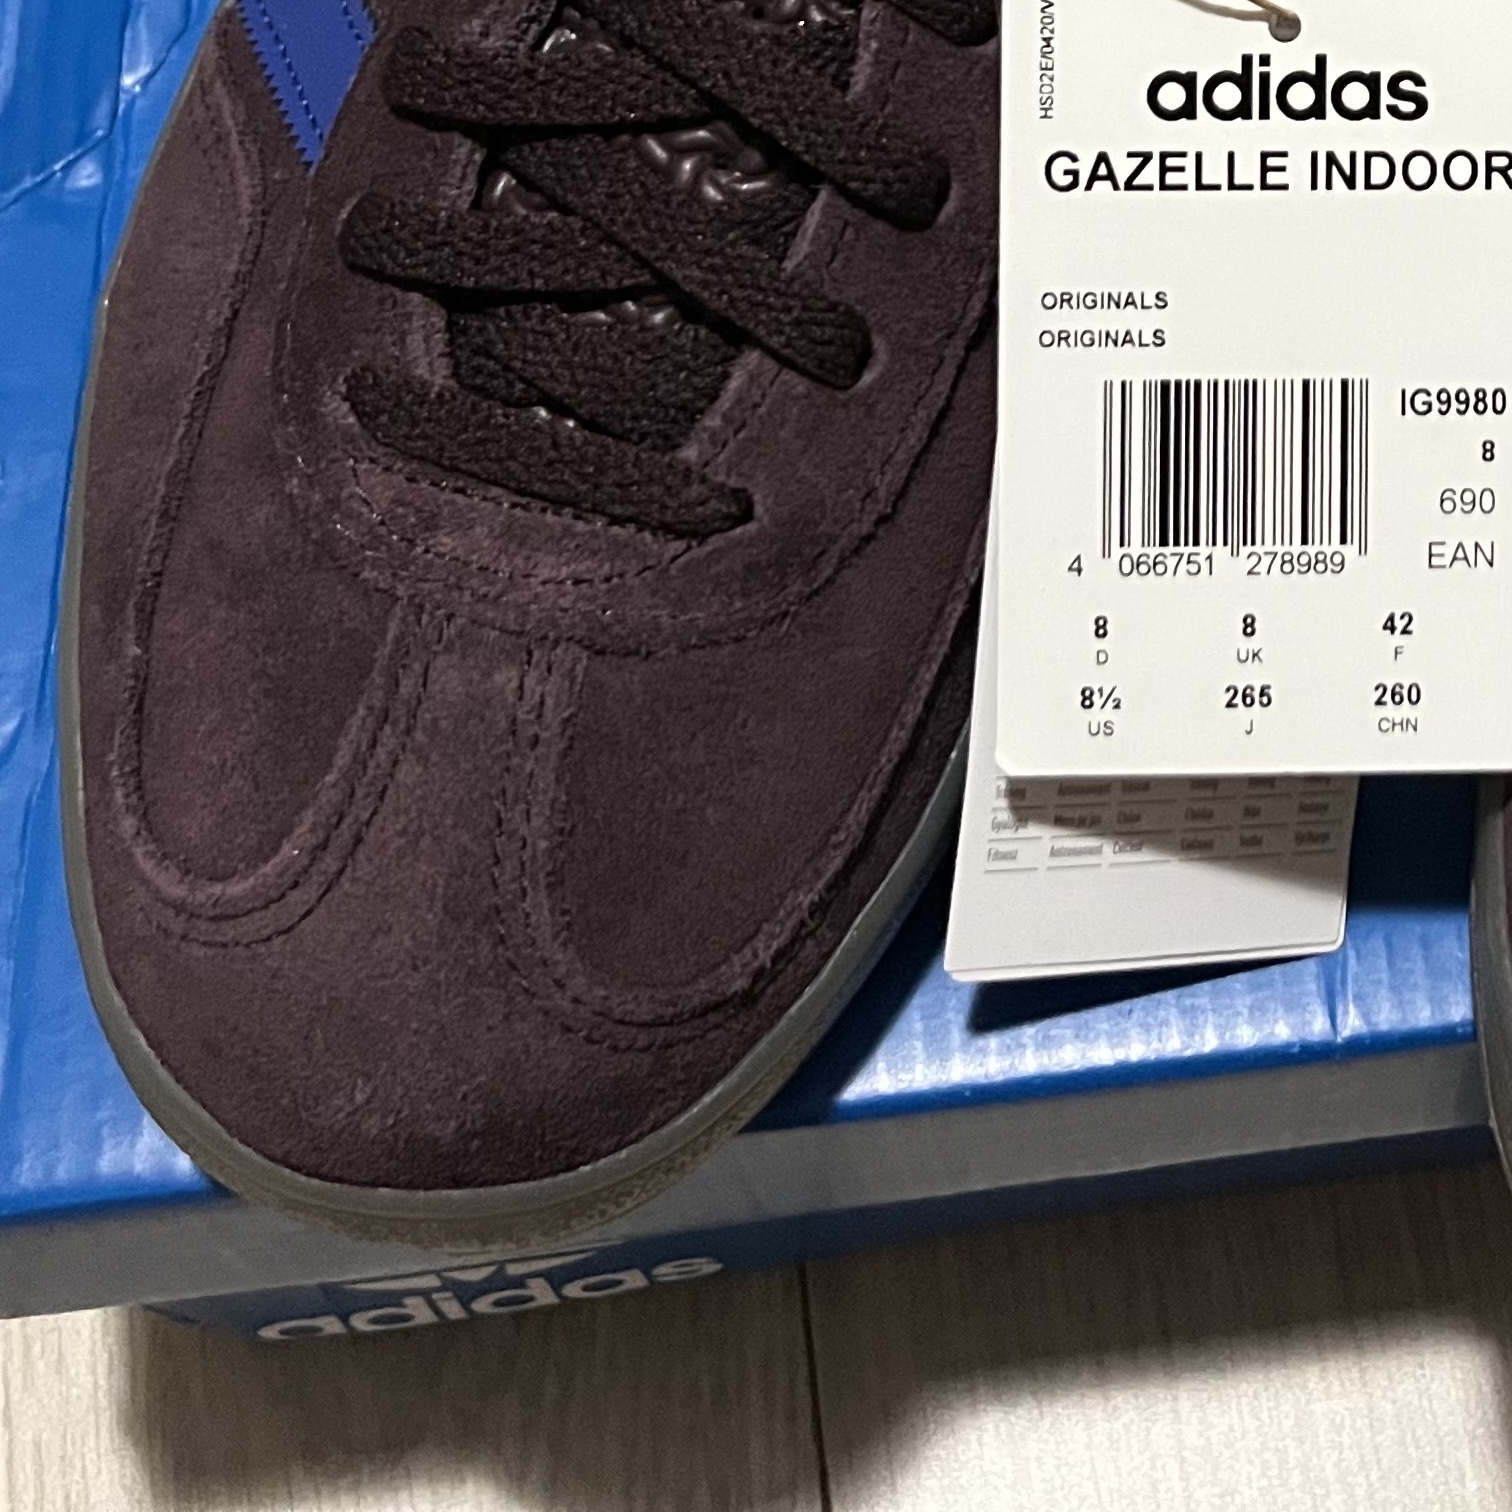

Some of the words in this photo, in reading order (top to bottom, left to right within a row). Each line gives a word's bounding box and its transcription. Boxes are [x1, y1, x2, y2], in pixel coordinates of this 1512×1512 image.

[1146, 52, 1429, 122] adidas
[1044, 149, 1290, 193] GAZELLE
[1040, 290, 1169, 311] ORIGINALS
[1038, 328, 1166, 348] ORIGINALS
[1400, 387, 1508, 416] IG9980
[1481, 439, 1496, 463] 8
[1439, 487, 1496, 515] 690
[1067, 554, 1084, 578] 4
[1118, 551, 1214, 578] 066751
[1246, 550, 1346, 576] 278989
[1427, 540, 1495, 570] EAN
[1093, 615, 1109, 640] 8
[1241, 614, 1257, 638] 8
[1381, 611, 1414, 636] 42
[1096, 649, 1109, 666] D
[1236, 647, 1263, 664] UK
[1394, 645, 1405, 662] F
[1224, 684, 1273, 709] 265
[1373, 682, 1422, 707] 260
[1088, 720, 1115, 737] US
[1244, 719, 1254, 736] J
[1377, 717, 1419, 734] CHN
[256, 1256, 724, 1343] adidas
